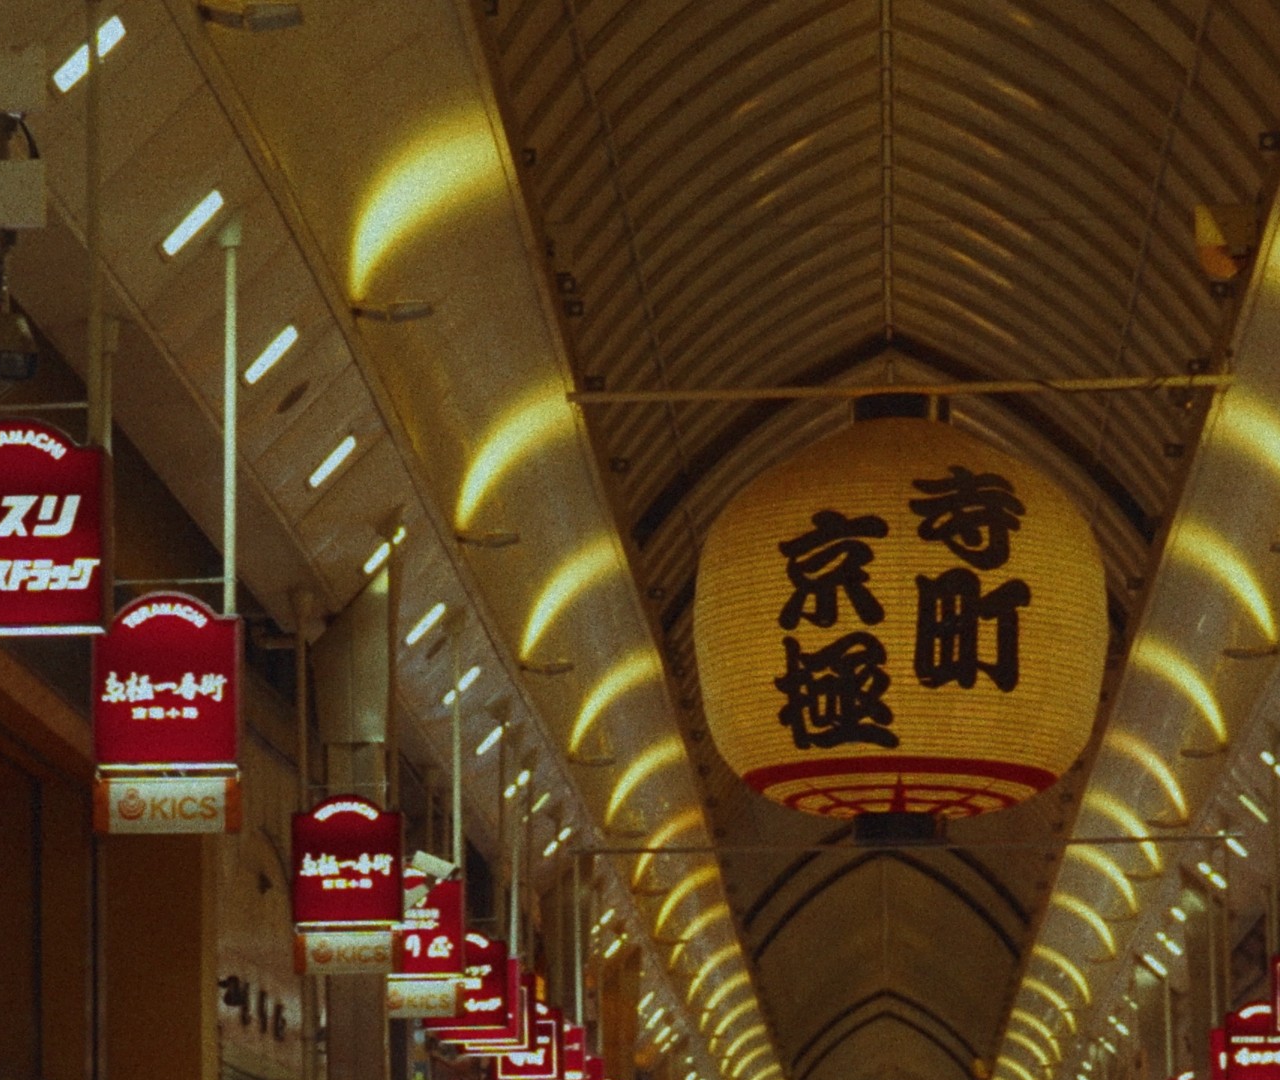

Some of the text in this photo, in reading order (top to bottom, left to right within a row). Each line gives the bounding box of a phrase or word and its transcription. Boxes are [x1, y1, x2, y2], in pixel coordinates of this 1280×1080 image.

[122, 603, 208, 629] TERAMACHI
[774, 510, 900, 750] 京極
[909, 465, 1032, 693] 寺町
[150, 794, 218, 821] KICS
